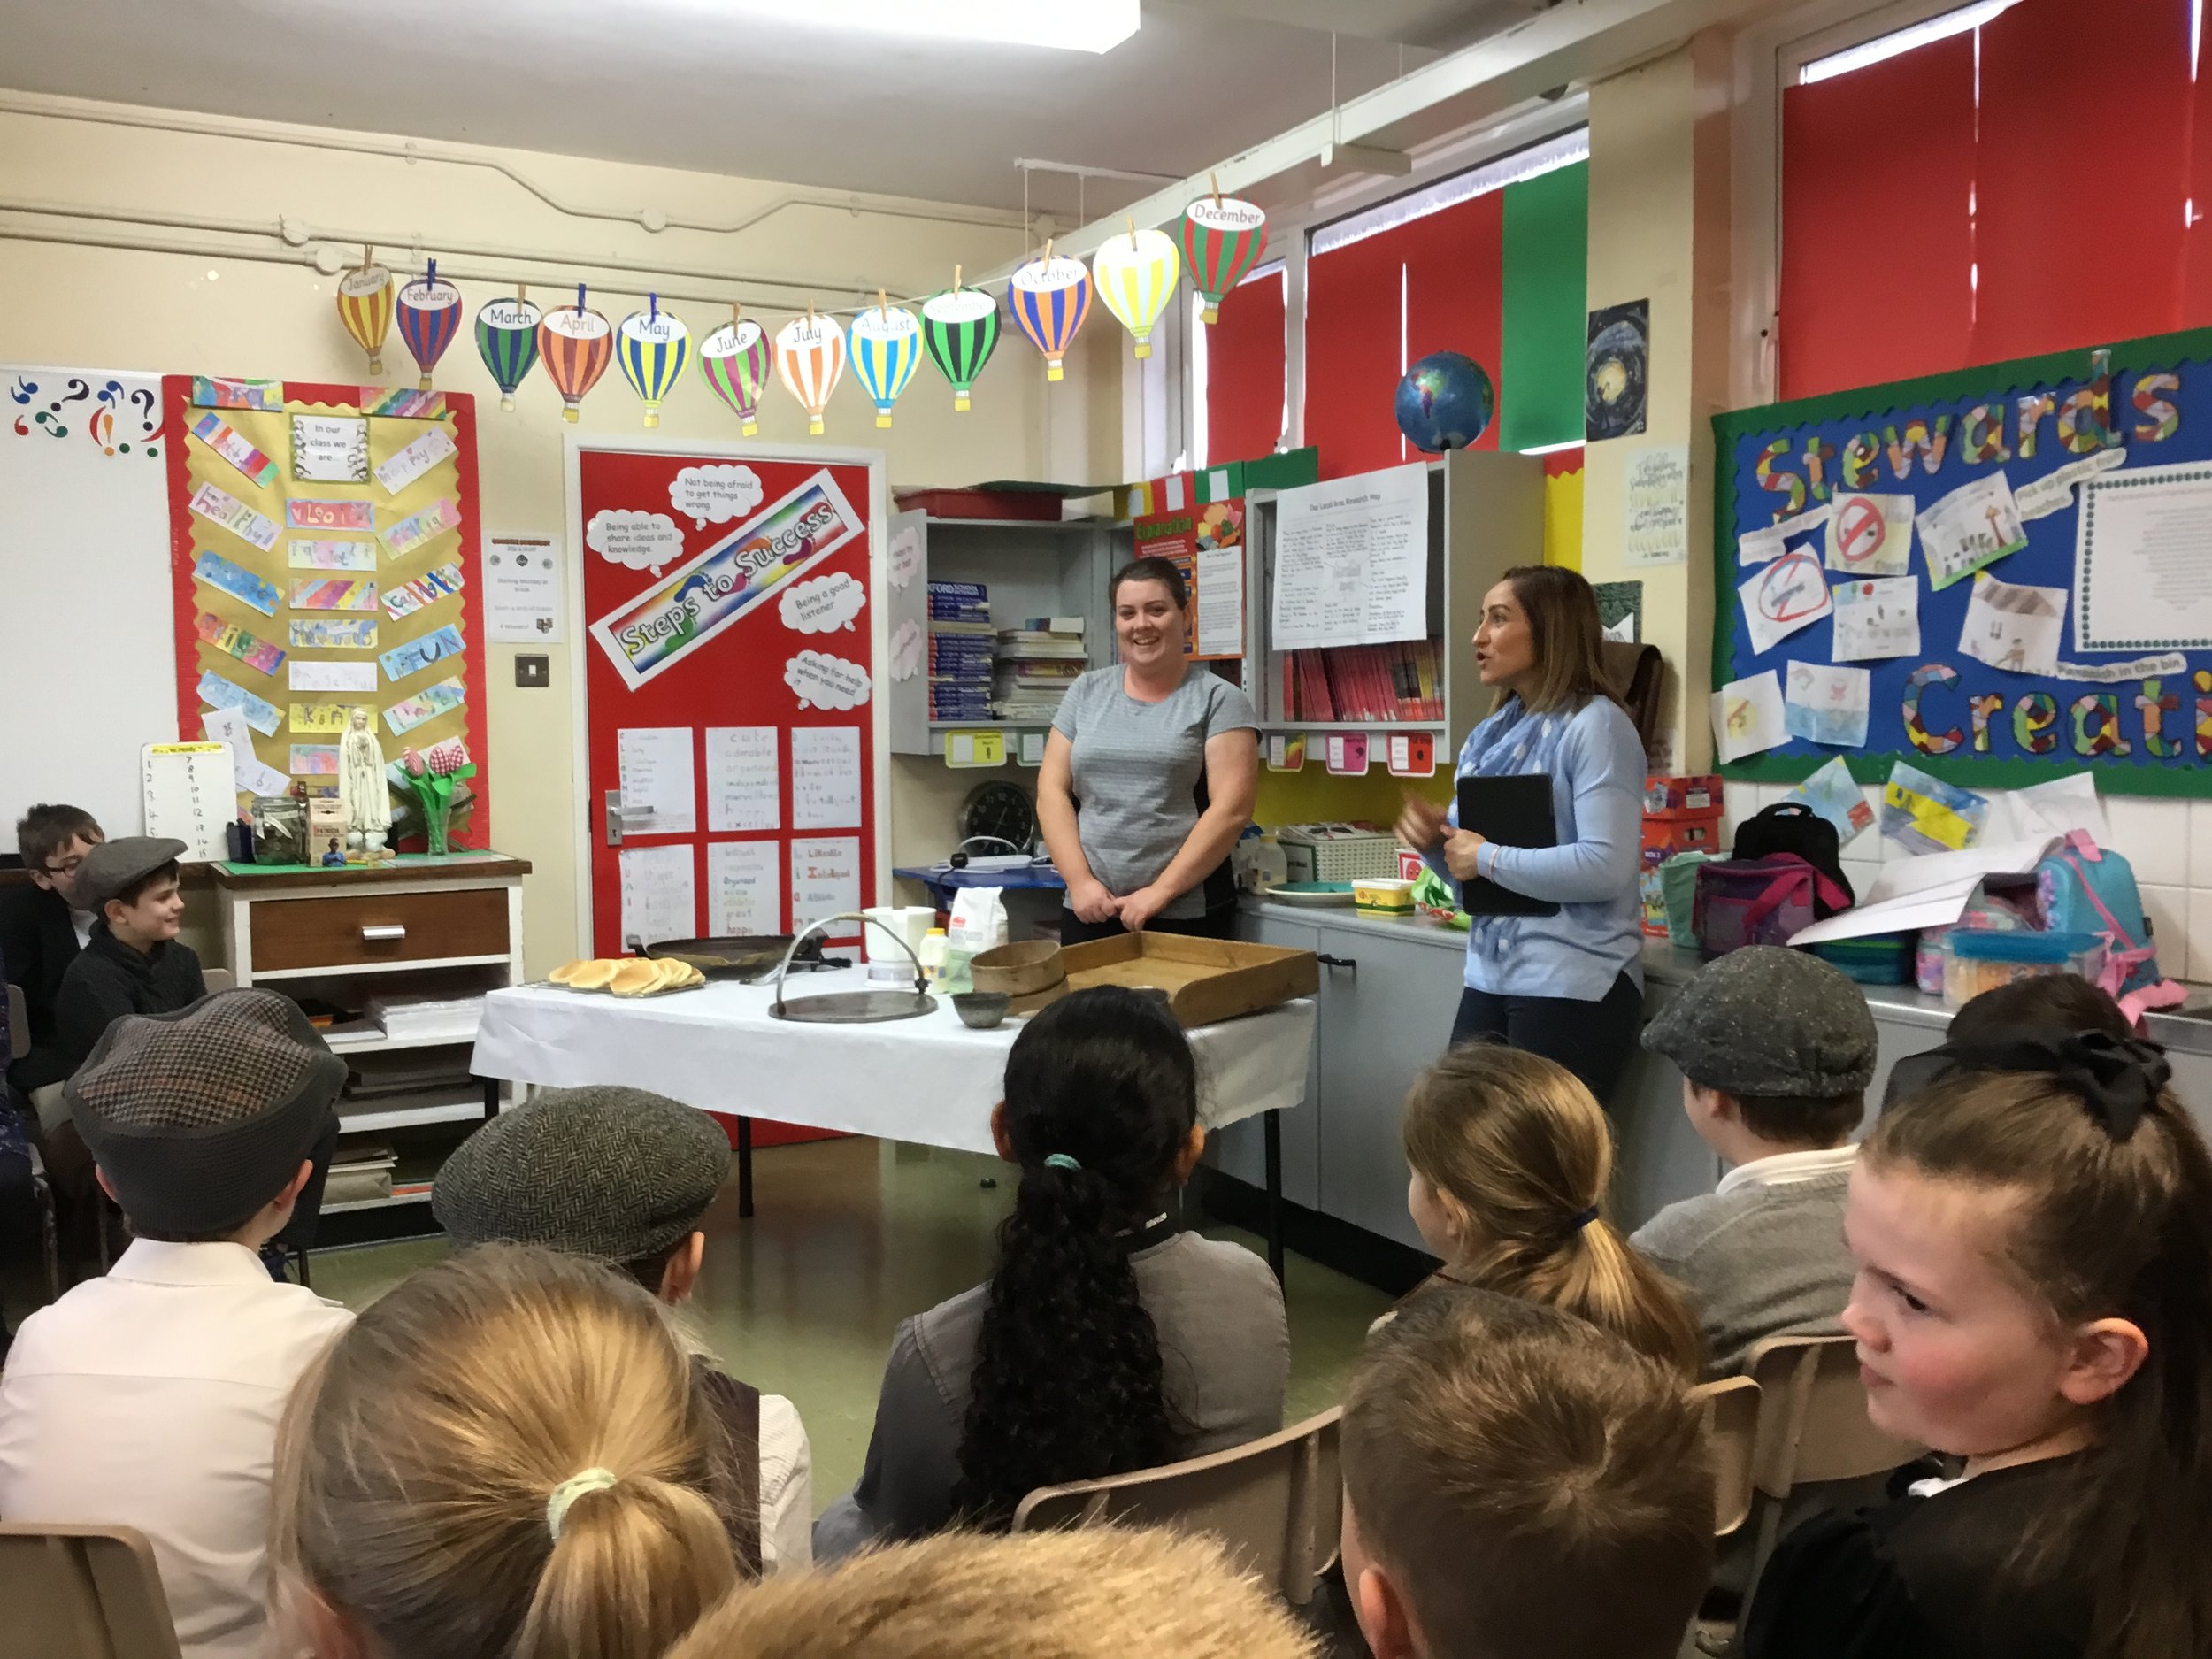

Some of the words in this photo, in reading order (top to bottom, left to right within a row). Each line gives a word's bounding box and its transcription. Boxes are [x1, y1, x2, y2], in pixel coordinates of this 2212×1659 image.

[1194, 204, 1261, 225] December
[347, 272, 385, 291] January
[1021, 265, 1078, 286] October
[406, 288, 453, 304] February
[490, 308, 532, 324] March
[559, 314, 595, 334] April
[639, 319, 671, 342] May
[793, 326, 822, 343] July
[716, 330, 748, 353] June
[310, 438, 332, 448] class
[1755, 349, 2180, 523] Stewards
[685, 477, 701, 487] Not
[703, 478, 726, 489] being
[727, 479, 753, 489] afraid
[696, 490, 710, 500] get
[713, 490, 738, 501] things
[605, 521, 629, 533] Being
[631, 521, 649, 531] able
[650, 522, 661, 531] to
[607, 534, 631, 542] share
[634, 533, 656, 542] ideas
[657, 533, 672, 542] and
[619, 596, 701, 655] Steps
[702, 574, 734, 603] to
[734, 502, 833, 579] Success
[795, 594, 821, 610] Being
[829, 579, 850, 597] good
[800, 601, 835, 621] listener
[801, 657, 829, 674] Asking
[831, 667, 844, 678] for
[845, 674, 864, 688] help
[2134, 662, 2157, 673] the
[797, 667, 818, 681] when
[819, 676, 834, 688] you
[835, 684, 856, 697] need
[730, 730, 768, 742] cute
[188, 764, 195, 773] 8
[146, 773, 153, 783] 2
[188, 774, 195, 783] 9
[193, 808, 204, 817] 12
[199, 849, 207, 858] 15
